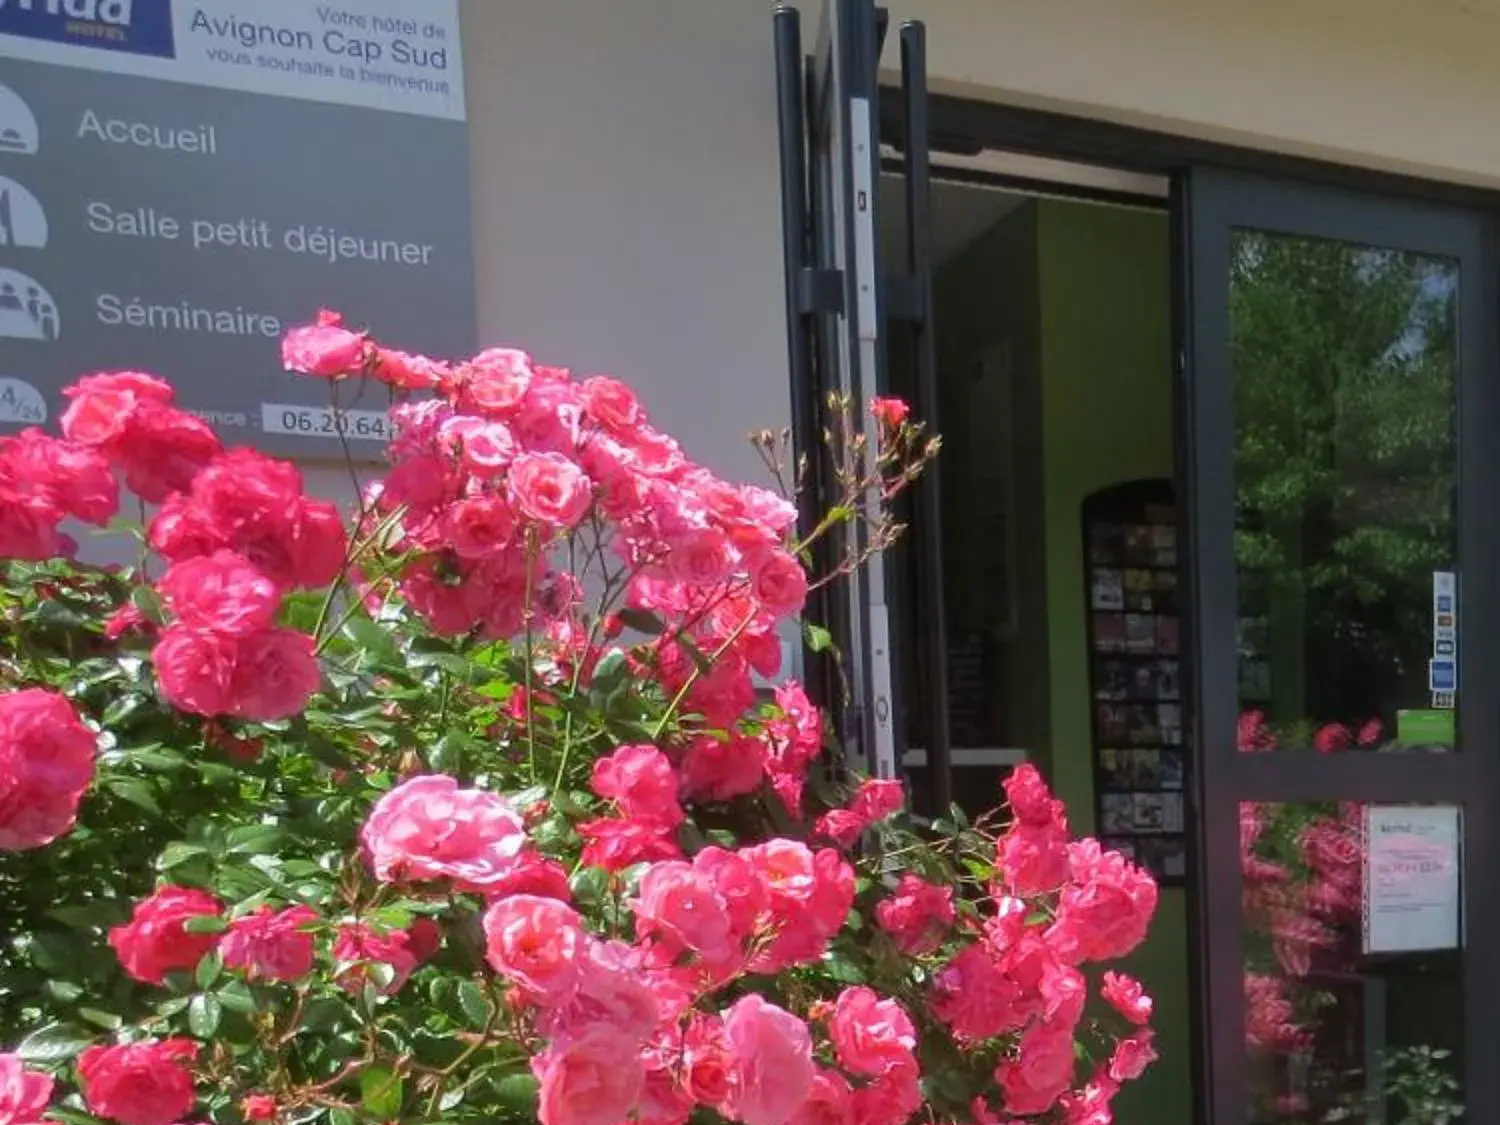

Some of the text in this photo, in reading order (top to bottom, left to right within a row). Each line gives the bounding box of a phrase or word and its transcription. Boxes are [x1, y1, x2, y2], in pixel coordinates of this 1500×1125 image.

[191, 9, 447, 70] Avignon Cap Sud
[316, 7, 367, 28] Votre
[372, 14, 418, 35] hôtel
[206, 48, 252, 65] vous
[257, 53, 335, 79] souhaite
[360, 67, 450, 95] bienvenue
[78, 109, 216, 154] Accueil
[86, 202, 435, 266] Salle petit déjeuner
[96, 294, 282, 338] Séminaire
